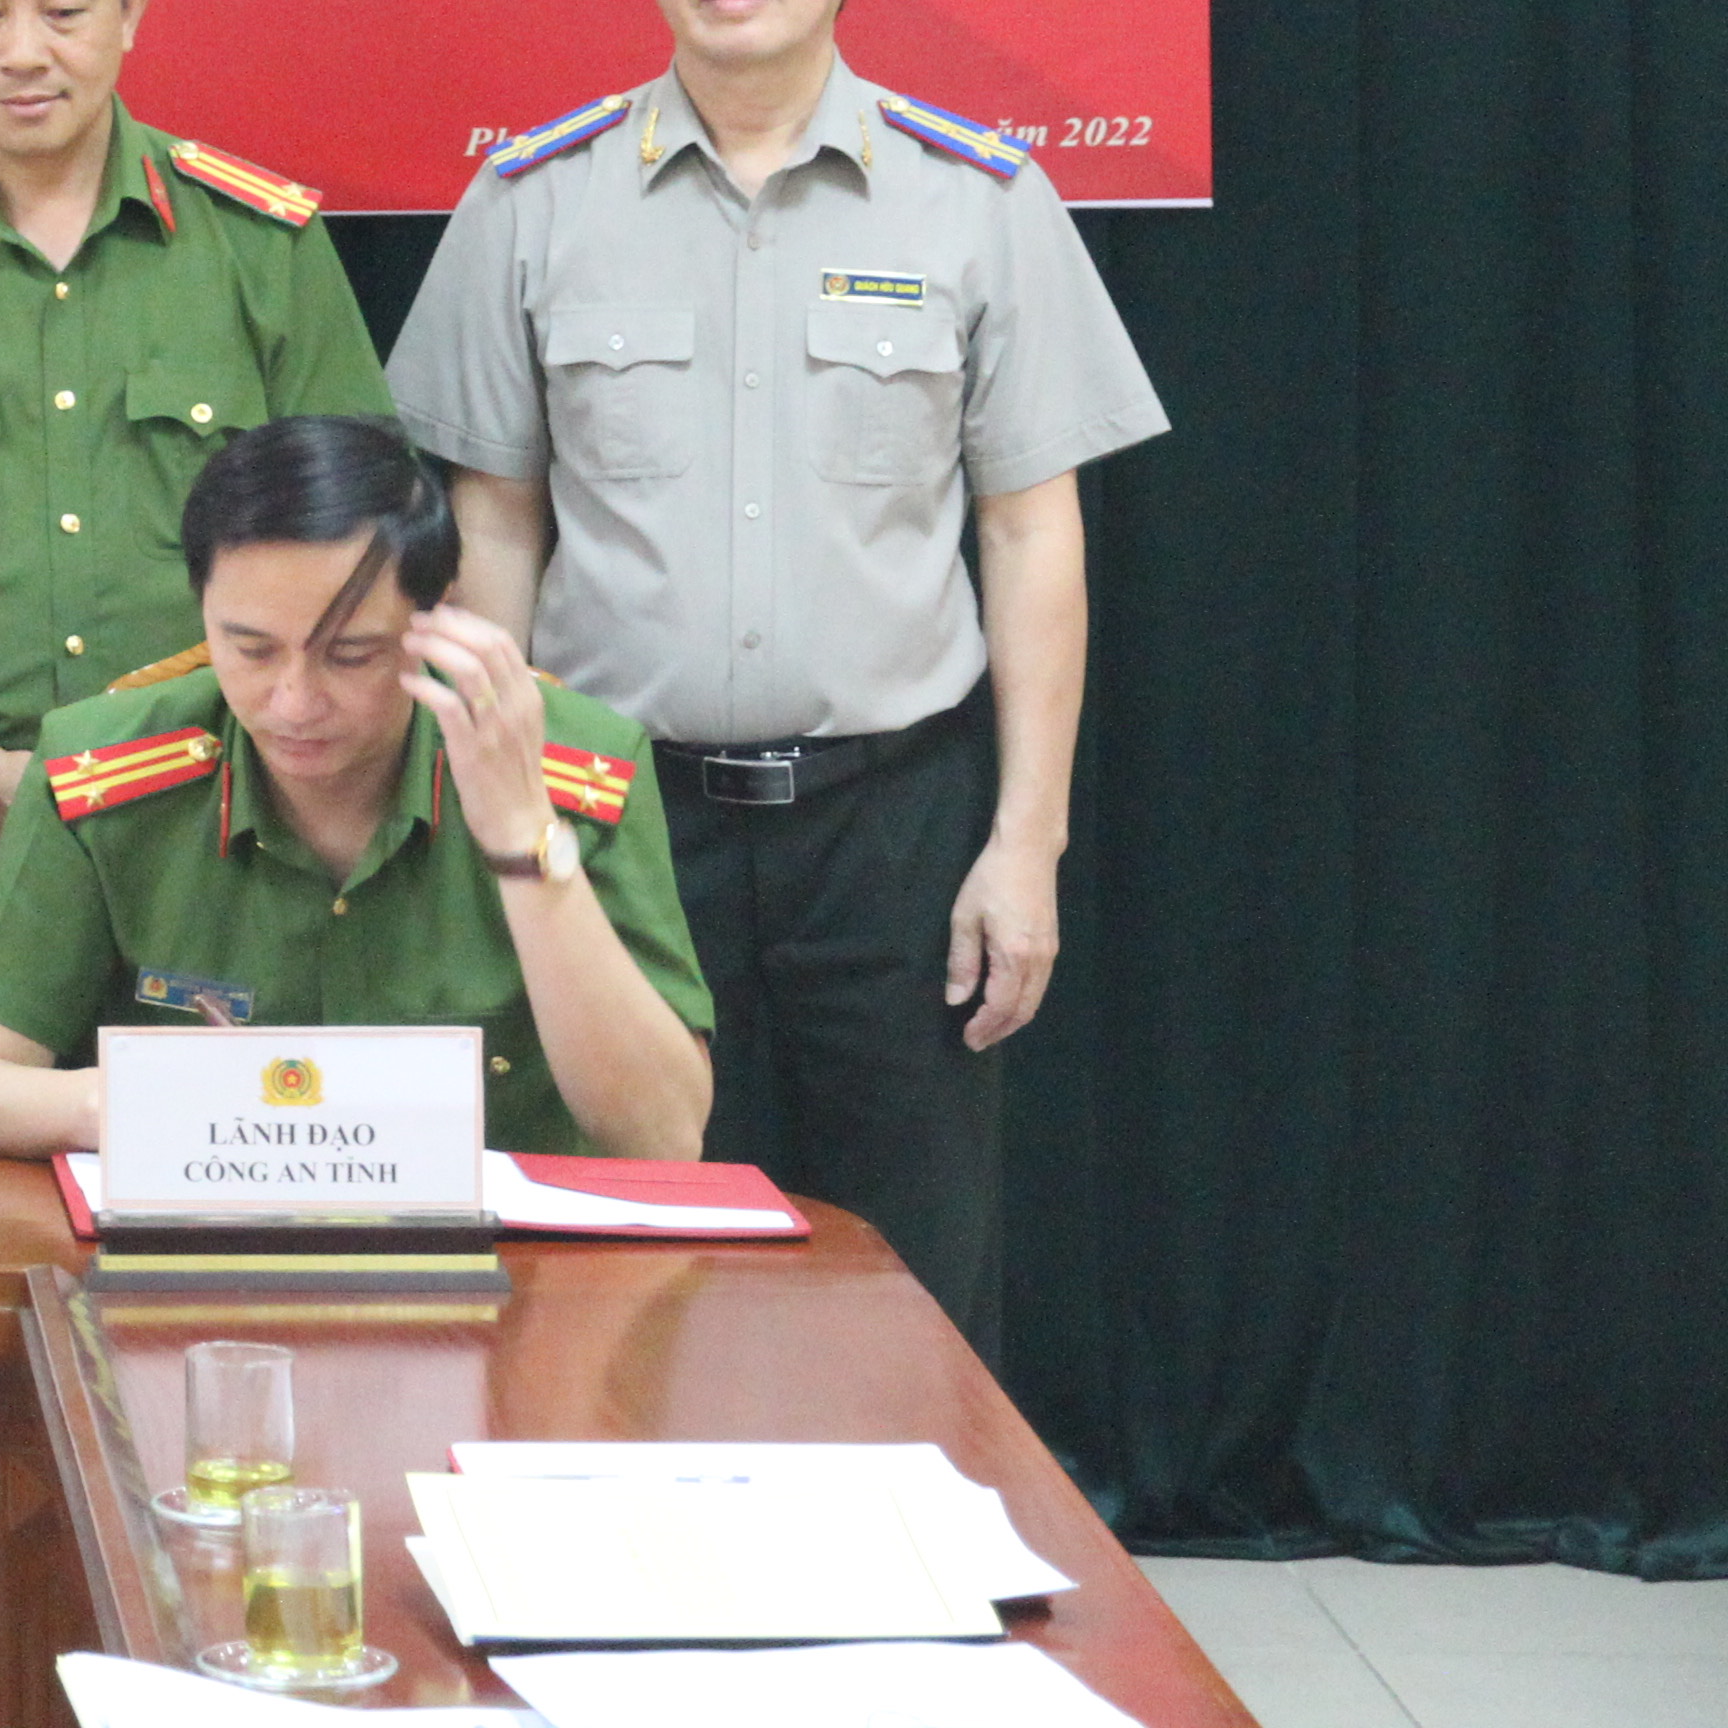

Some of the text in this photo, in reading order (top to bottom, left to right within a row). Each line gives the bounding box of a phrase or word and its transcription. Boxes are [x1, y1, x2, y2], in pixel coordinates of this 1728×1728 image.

[1060, 116, 1152, 147] 2022
[209, 1117, 376, 1152] LÃNH ĐẠO
[184, 1156, 397, 1183] CÔNG AN TỈNH
